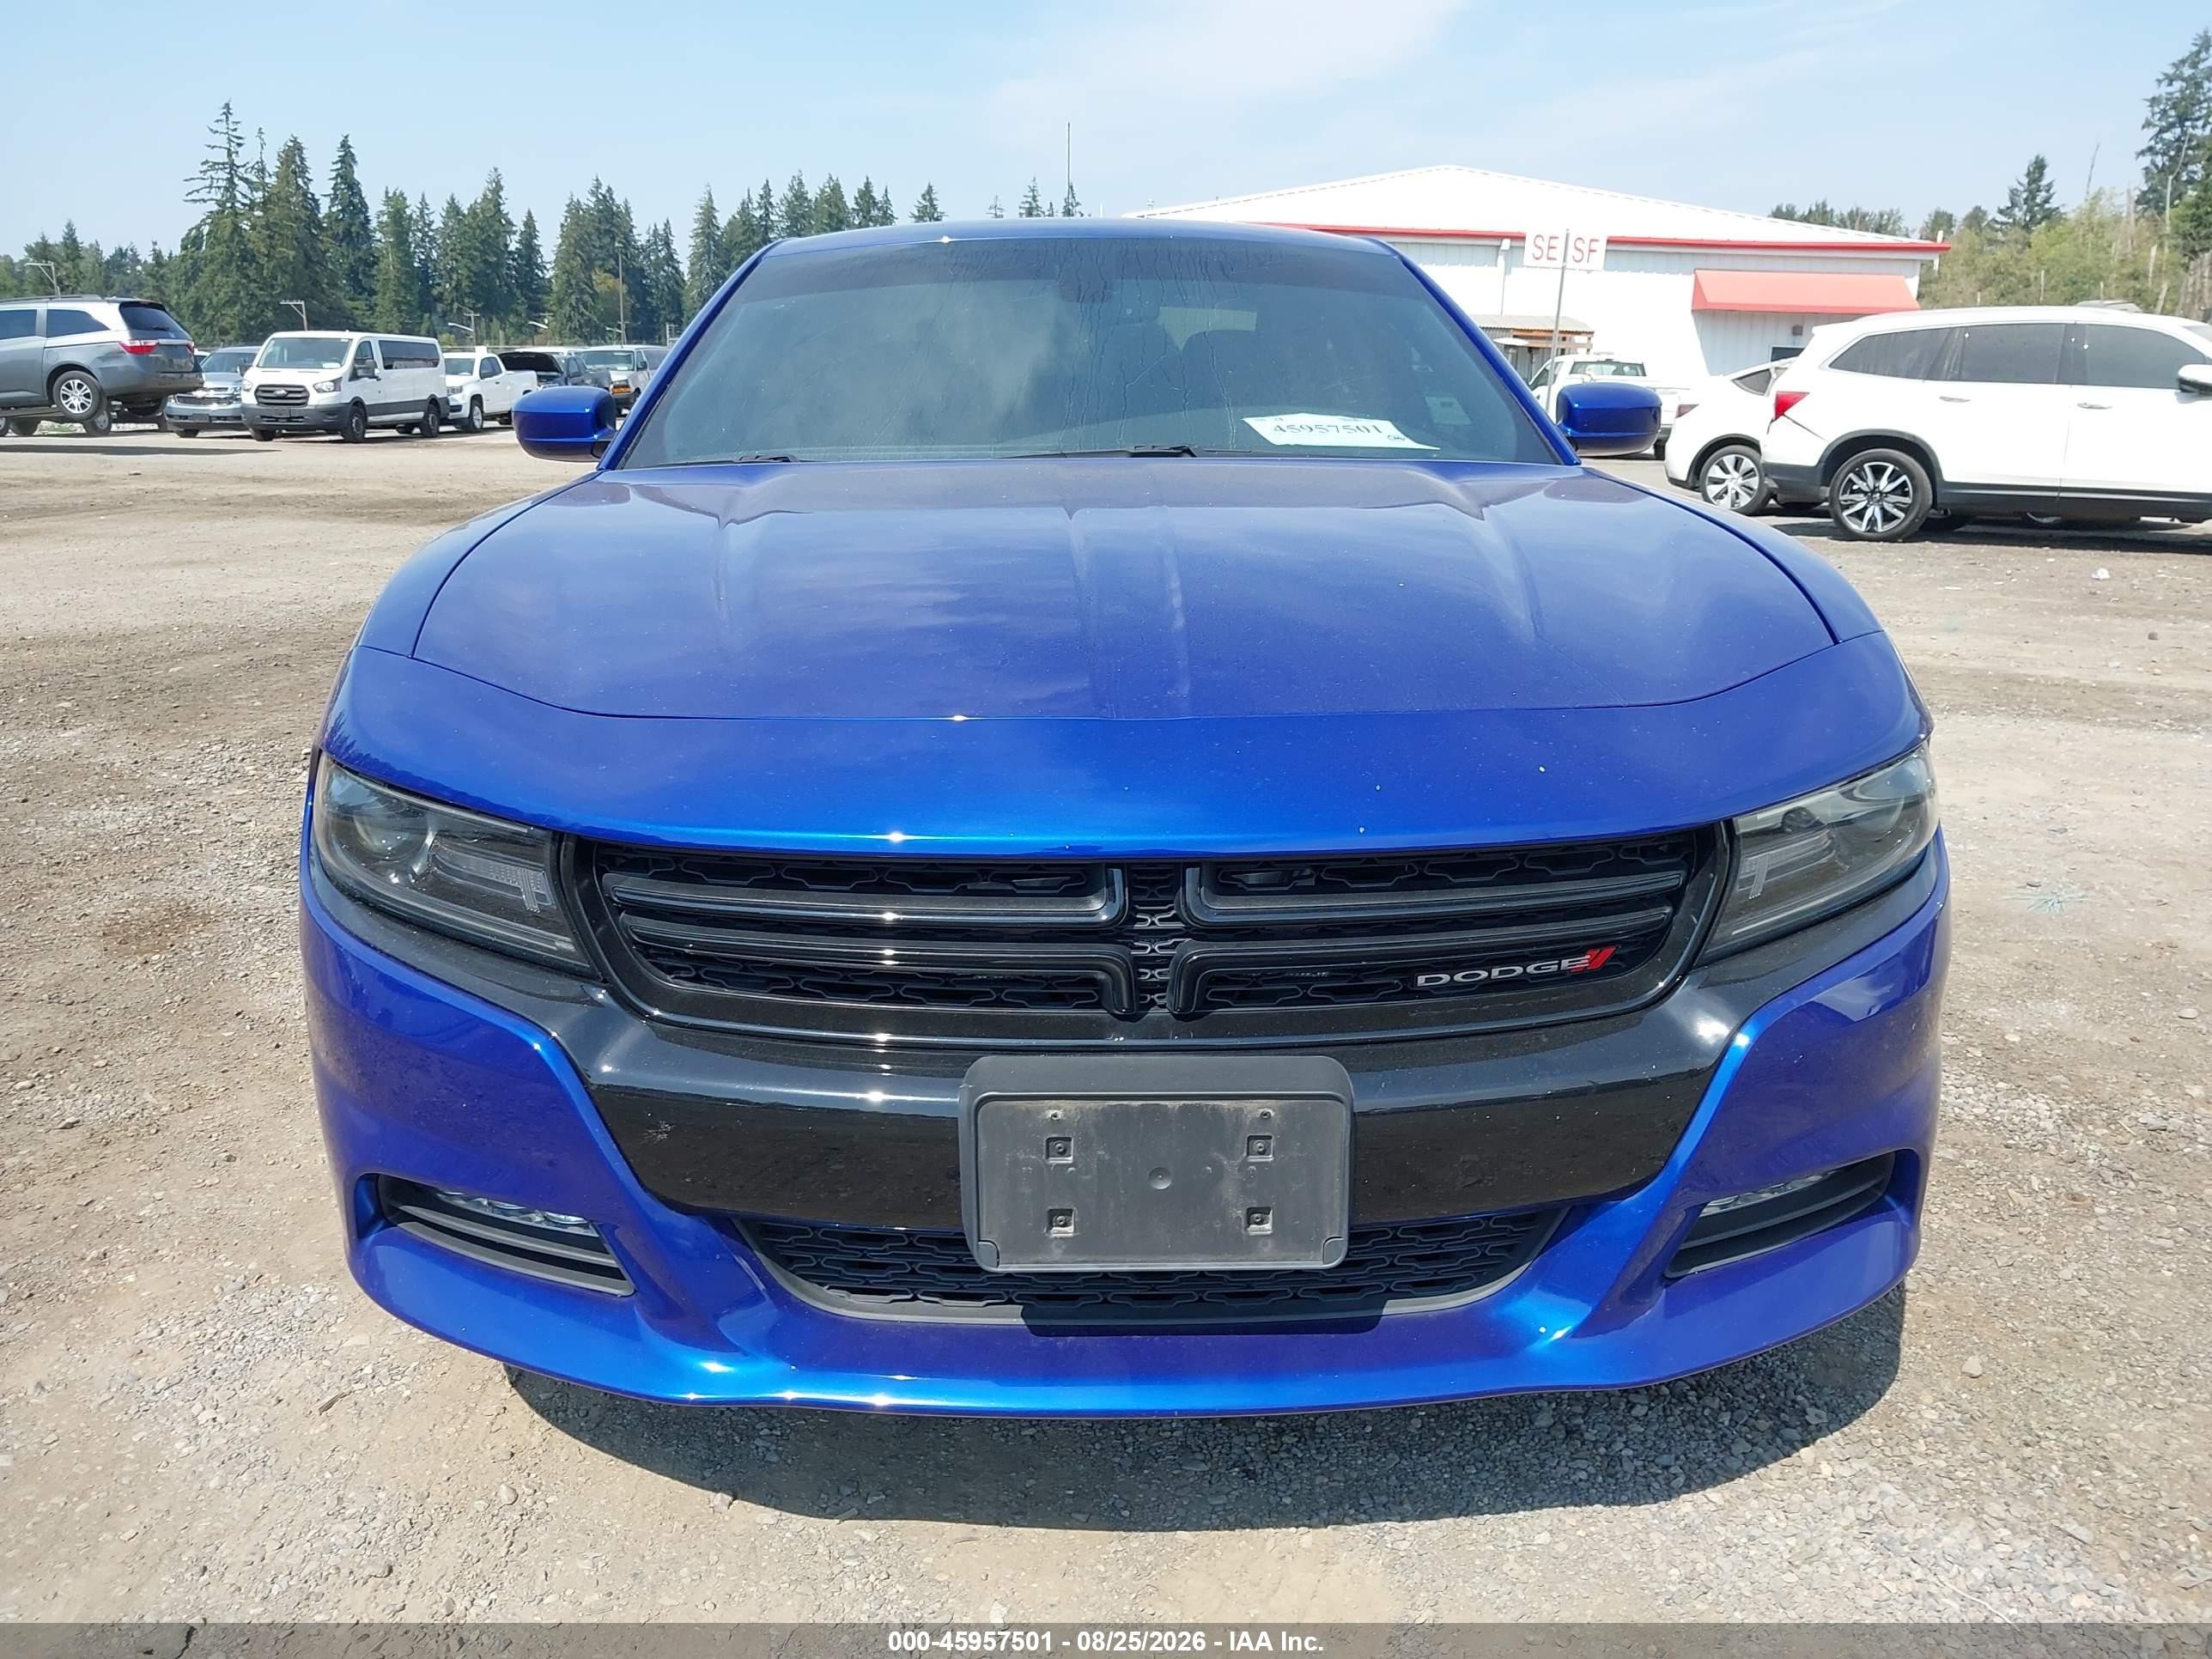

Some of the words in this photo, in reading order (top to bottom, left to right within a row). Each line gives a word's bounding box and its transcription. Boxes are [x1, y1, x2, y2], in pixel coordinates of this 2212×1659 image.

[1532, 234, 1559, 260] SE
[1572, 237, 1600, 263] SF
[1273, 424, 1383, 434] 45957501
[1417, 954, 1591, 987] DODGE
